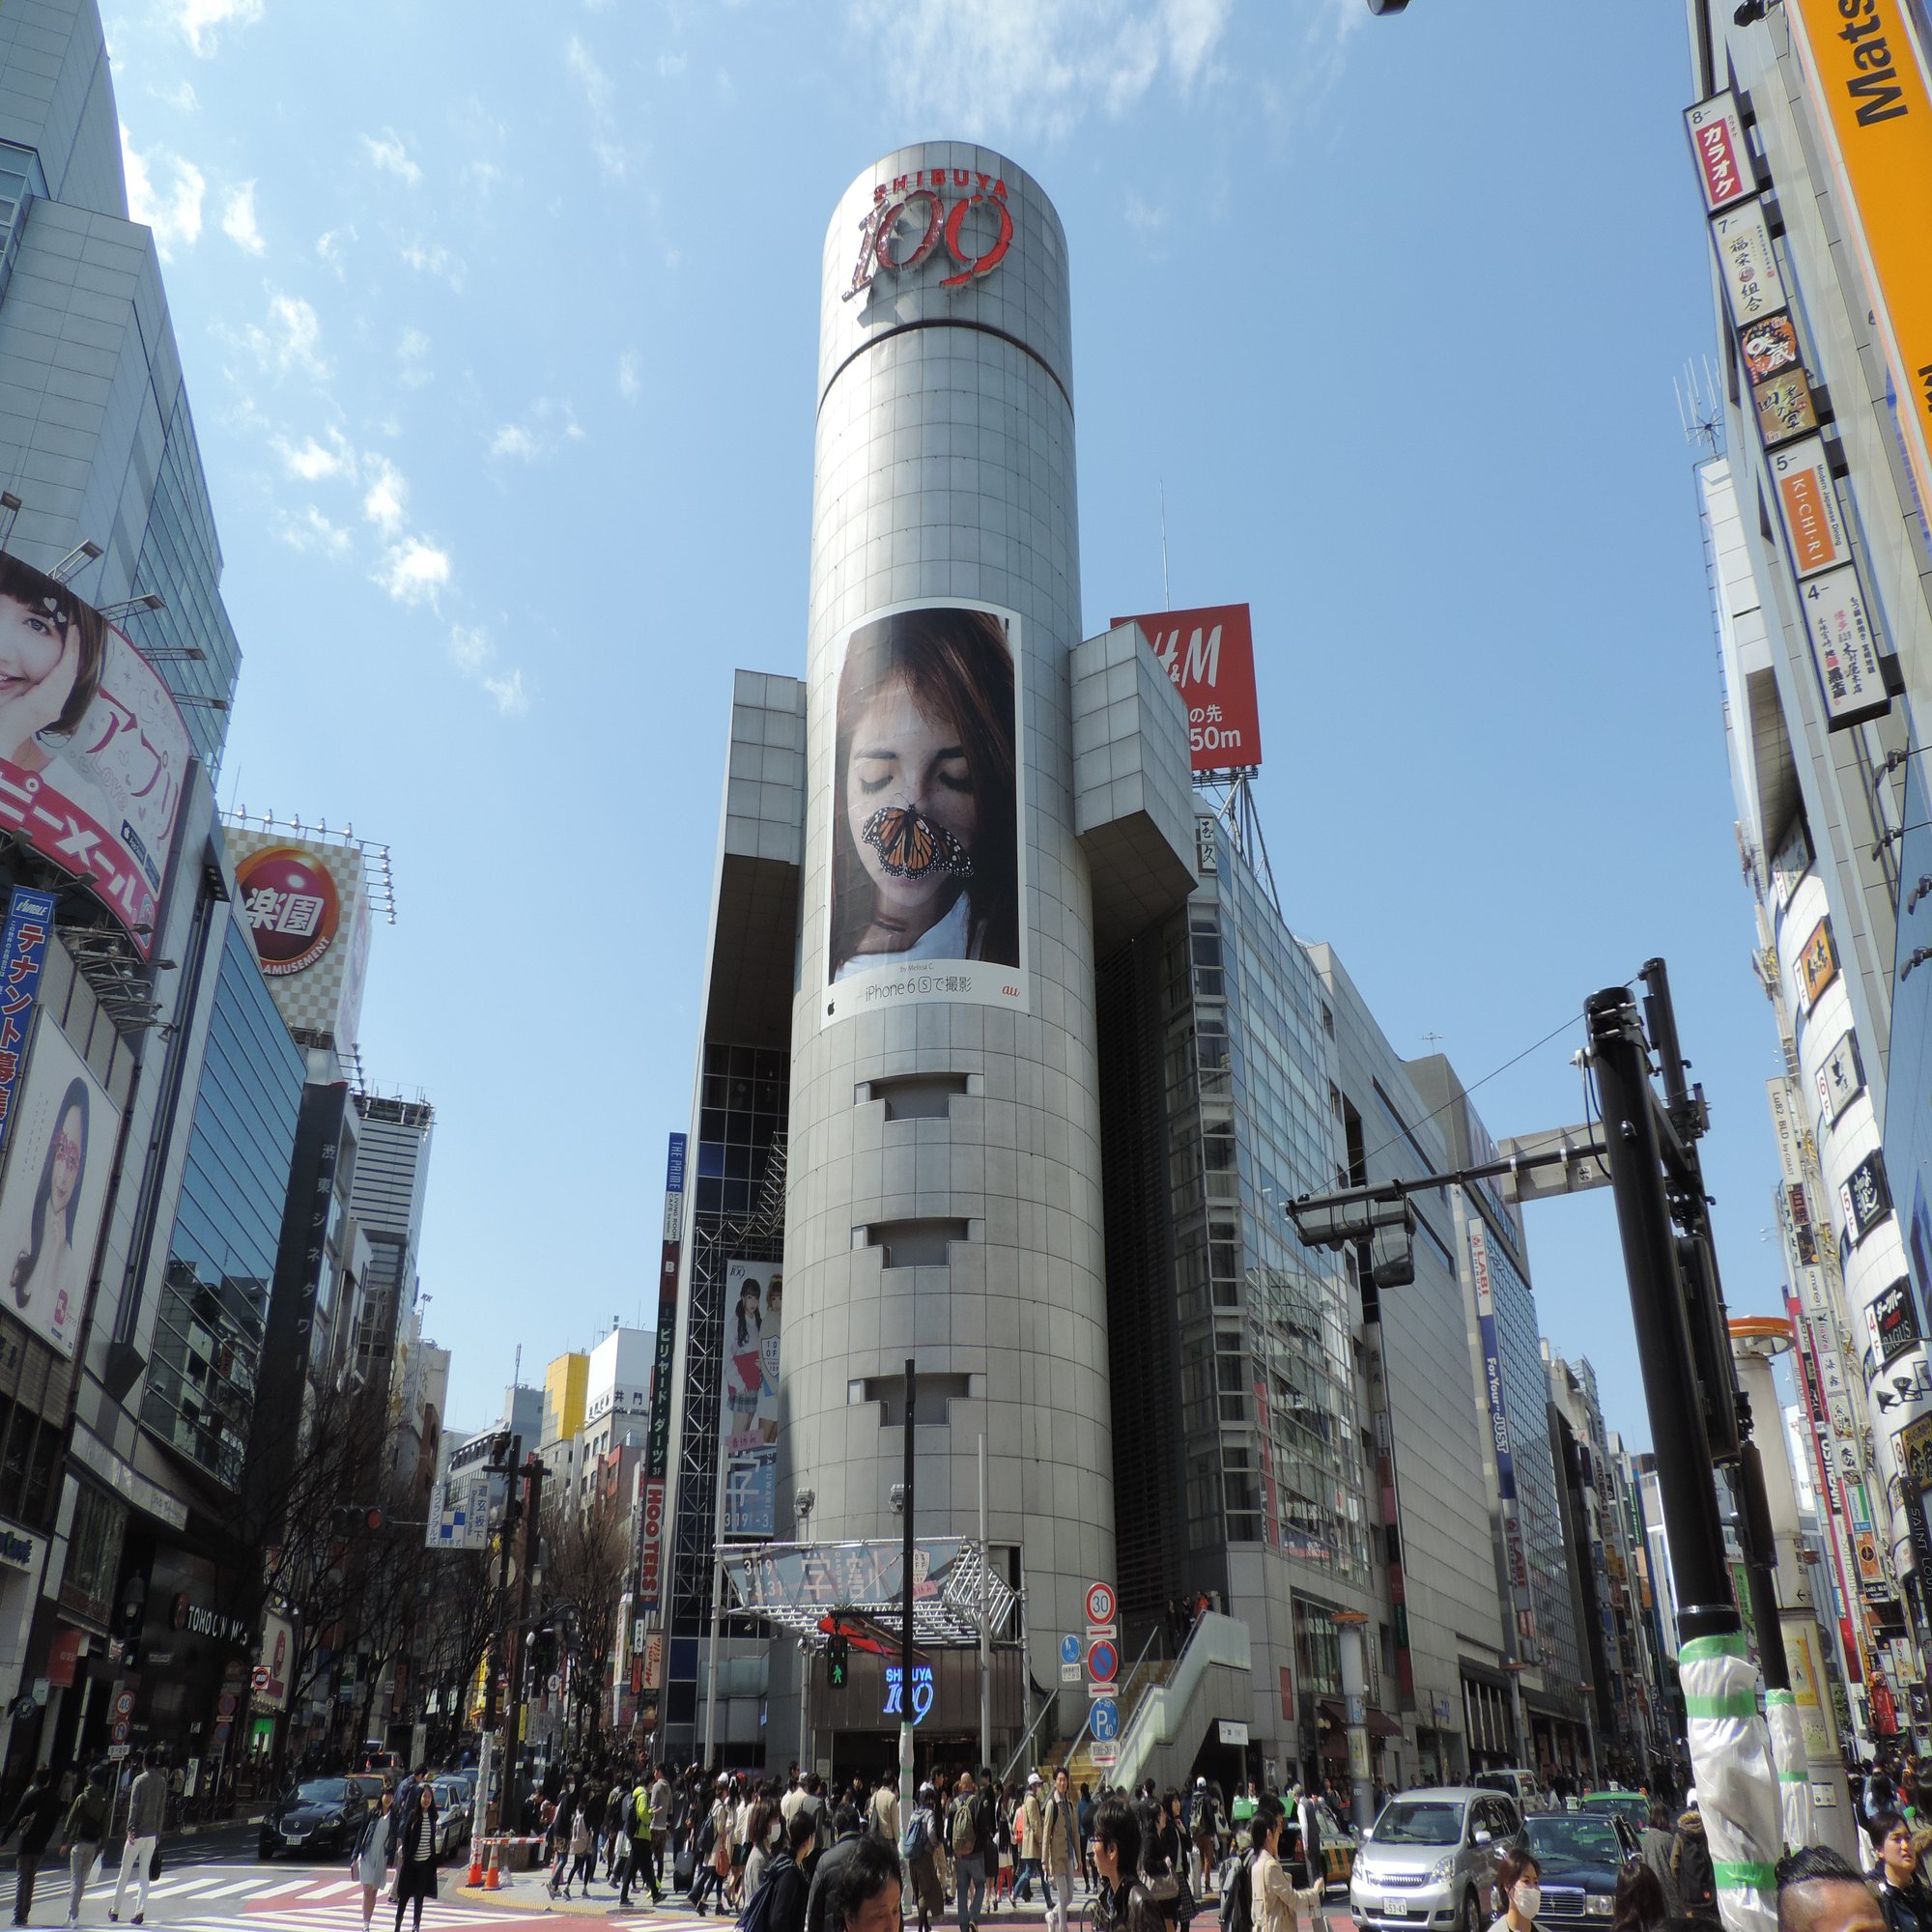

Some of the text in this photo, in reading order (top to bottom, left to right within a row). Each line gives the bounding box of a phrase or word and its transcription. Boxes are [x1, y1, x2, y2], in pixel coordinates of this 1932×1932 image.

[1704, 127, 1735, 197] カラオケ
[873, 167, 1008, 204] SHIBUYA
[841, 188, 1013, 302] 109
[1817, 464, 1842, 547] Modern Japanese Dining
[1153, 625, 1222, 688] H&M
[1189, 705, 1223, 723] の先
[244, 887, 325, 937] 楽園
[263, 936, 330, 976] AMUSEMENT
[908, 963, 928, 972] Melissa
[866, 981, 905, 1003] iPhone
[1002, 984, 1021, 998] au
[1819, 1075, 1830, 1116] 6F
[669, 1141, 684, 1189] THE PRIME
[1843, 1191, 1854, 1234] 5F
[1477, 1250, 1490, 1295] LABI
[1869, 1313, 1880, 1356] 4F
[1883, 1320, 1912, 1354] BAGUS
[1488, 1357, 1496, 1376] For
[653, 1327, 671, 1464] ビリヤード・ダーツ
[726, 1450, 761, 1507] 学
[641, 1489, 663, 1592] HOOTERS
[1912, 1508, 1928, 1550] SAINT
[1512, 1537, 1526, 1587] LABI
[1841, 1539, 1857, 1592] SoftBank
[187, 1605, 213, 1635] TOHO
[1093, 1596, 1109, 1613] 30
[886, 1667, 933, 1682] SHIUYA
[119, 1698, 130, 1709] 40
[1096, 1710, 1114, 1737] P 40
